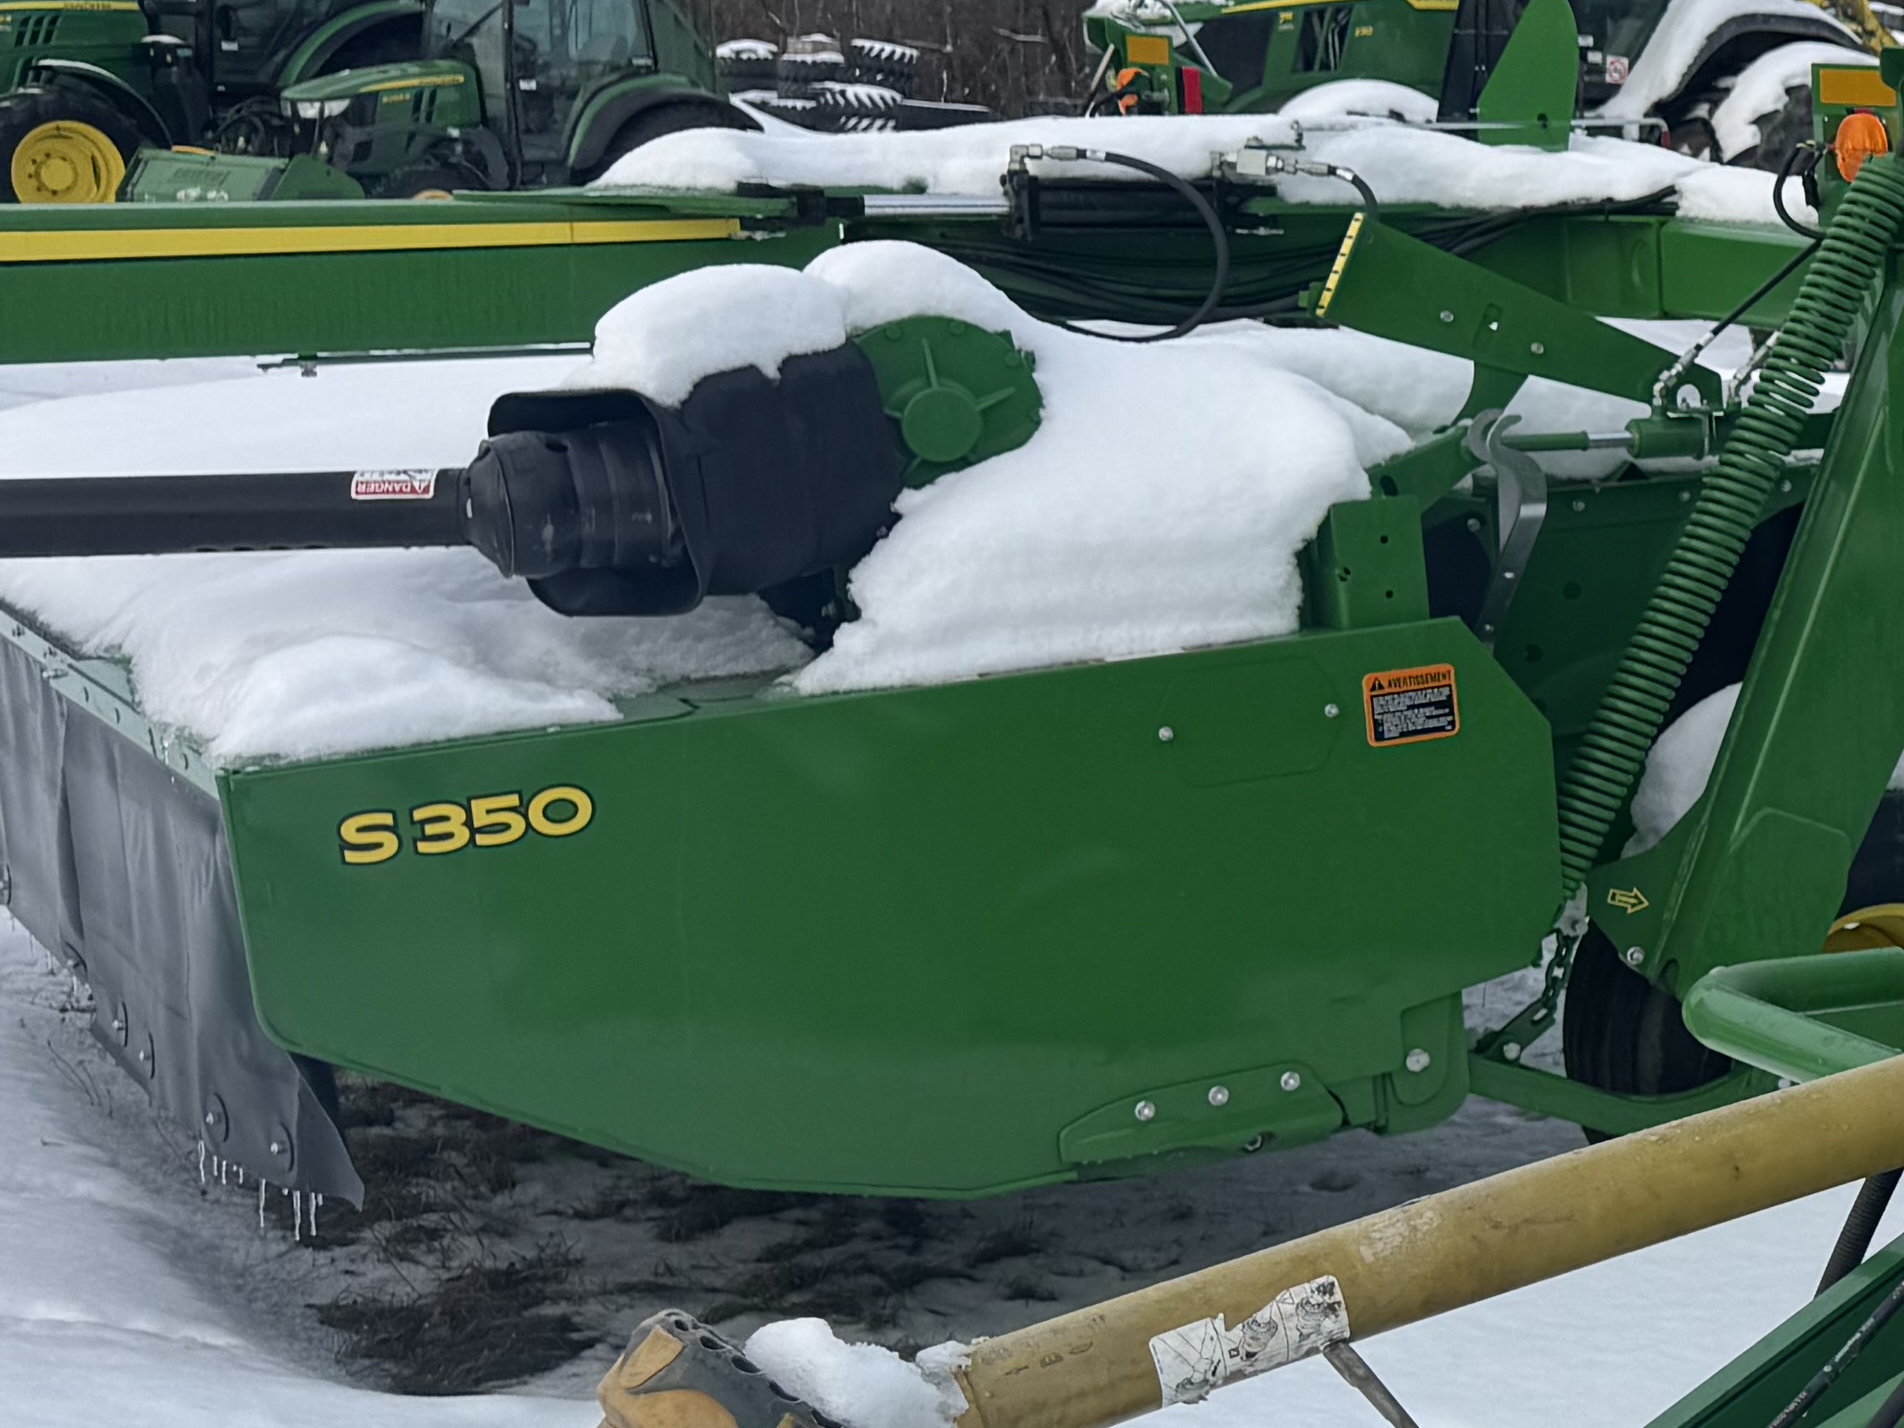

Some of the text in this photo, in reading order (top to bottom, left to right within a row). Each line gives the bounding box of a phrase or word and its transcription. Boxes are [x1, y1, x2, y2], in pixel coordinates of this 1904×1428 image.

[357, 481, 411, 493] DANGER
[1388, 670, 1451, 688] AVERTISSEMENT
[339, 785, 594, 864] S 350
